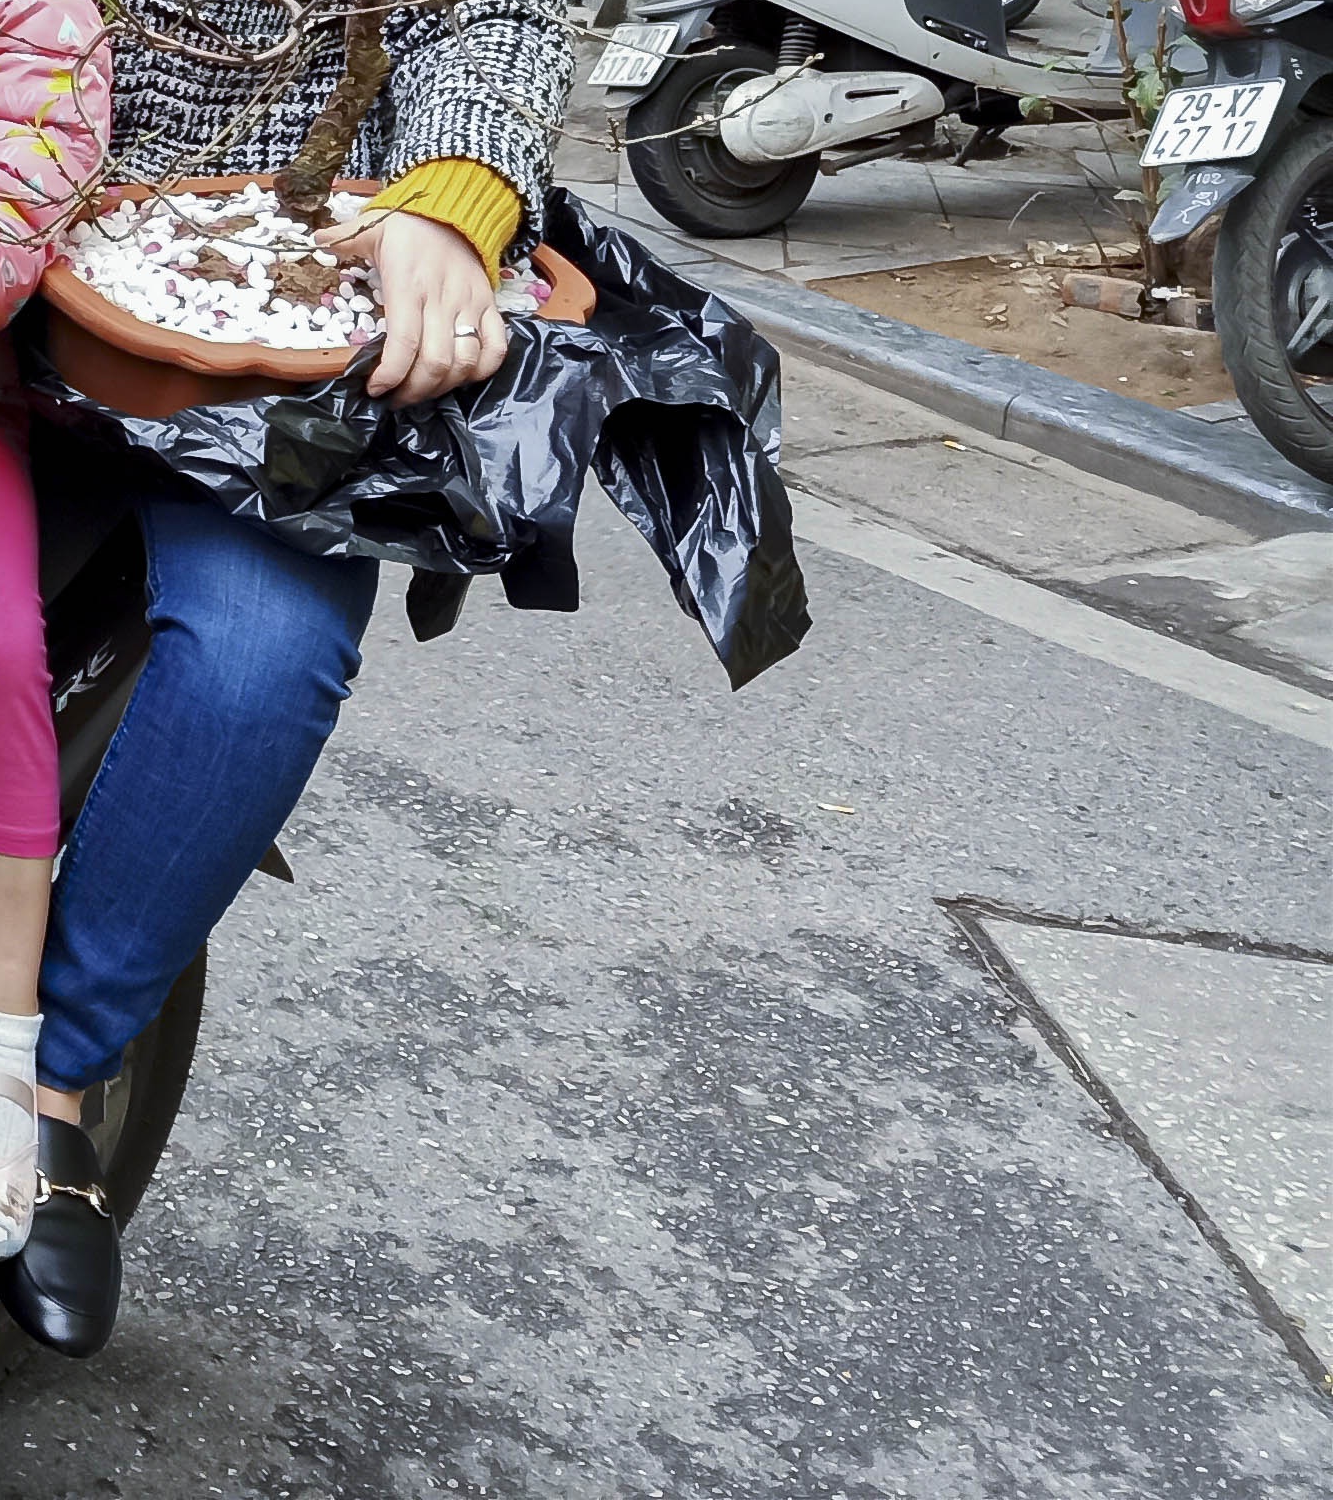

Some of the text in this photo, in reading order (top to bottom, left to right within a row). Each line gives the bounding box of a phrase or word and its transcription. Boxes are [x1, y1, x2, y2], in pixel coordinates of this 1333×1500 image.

[1174, 86, 1265, 125] 29-X7
[1152, 120, 1257, 160] 427 17
